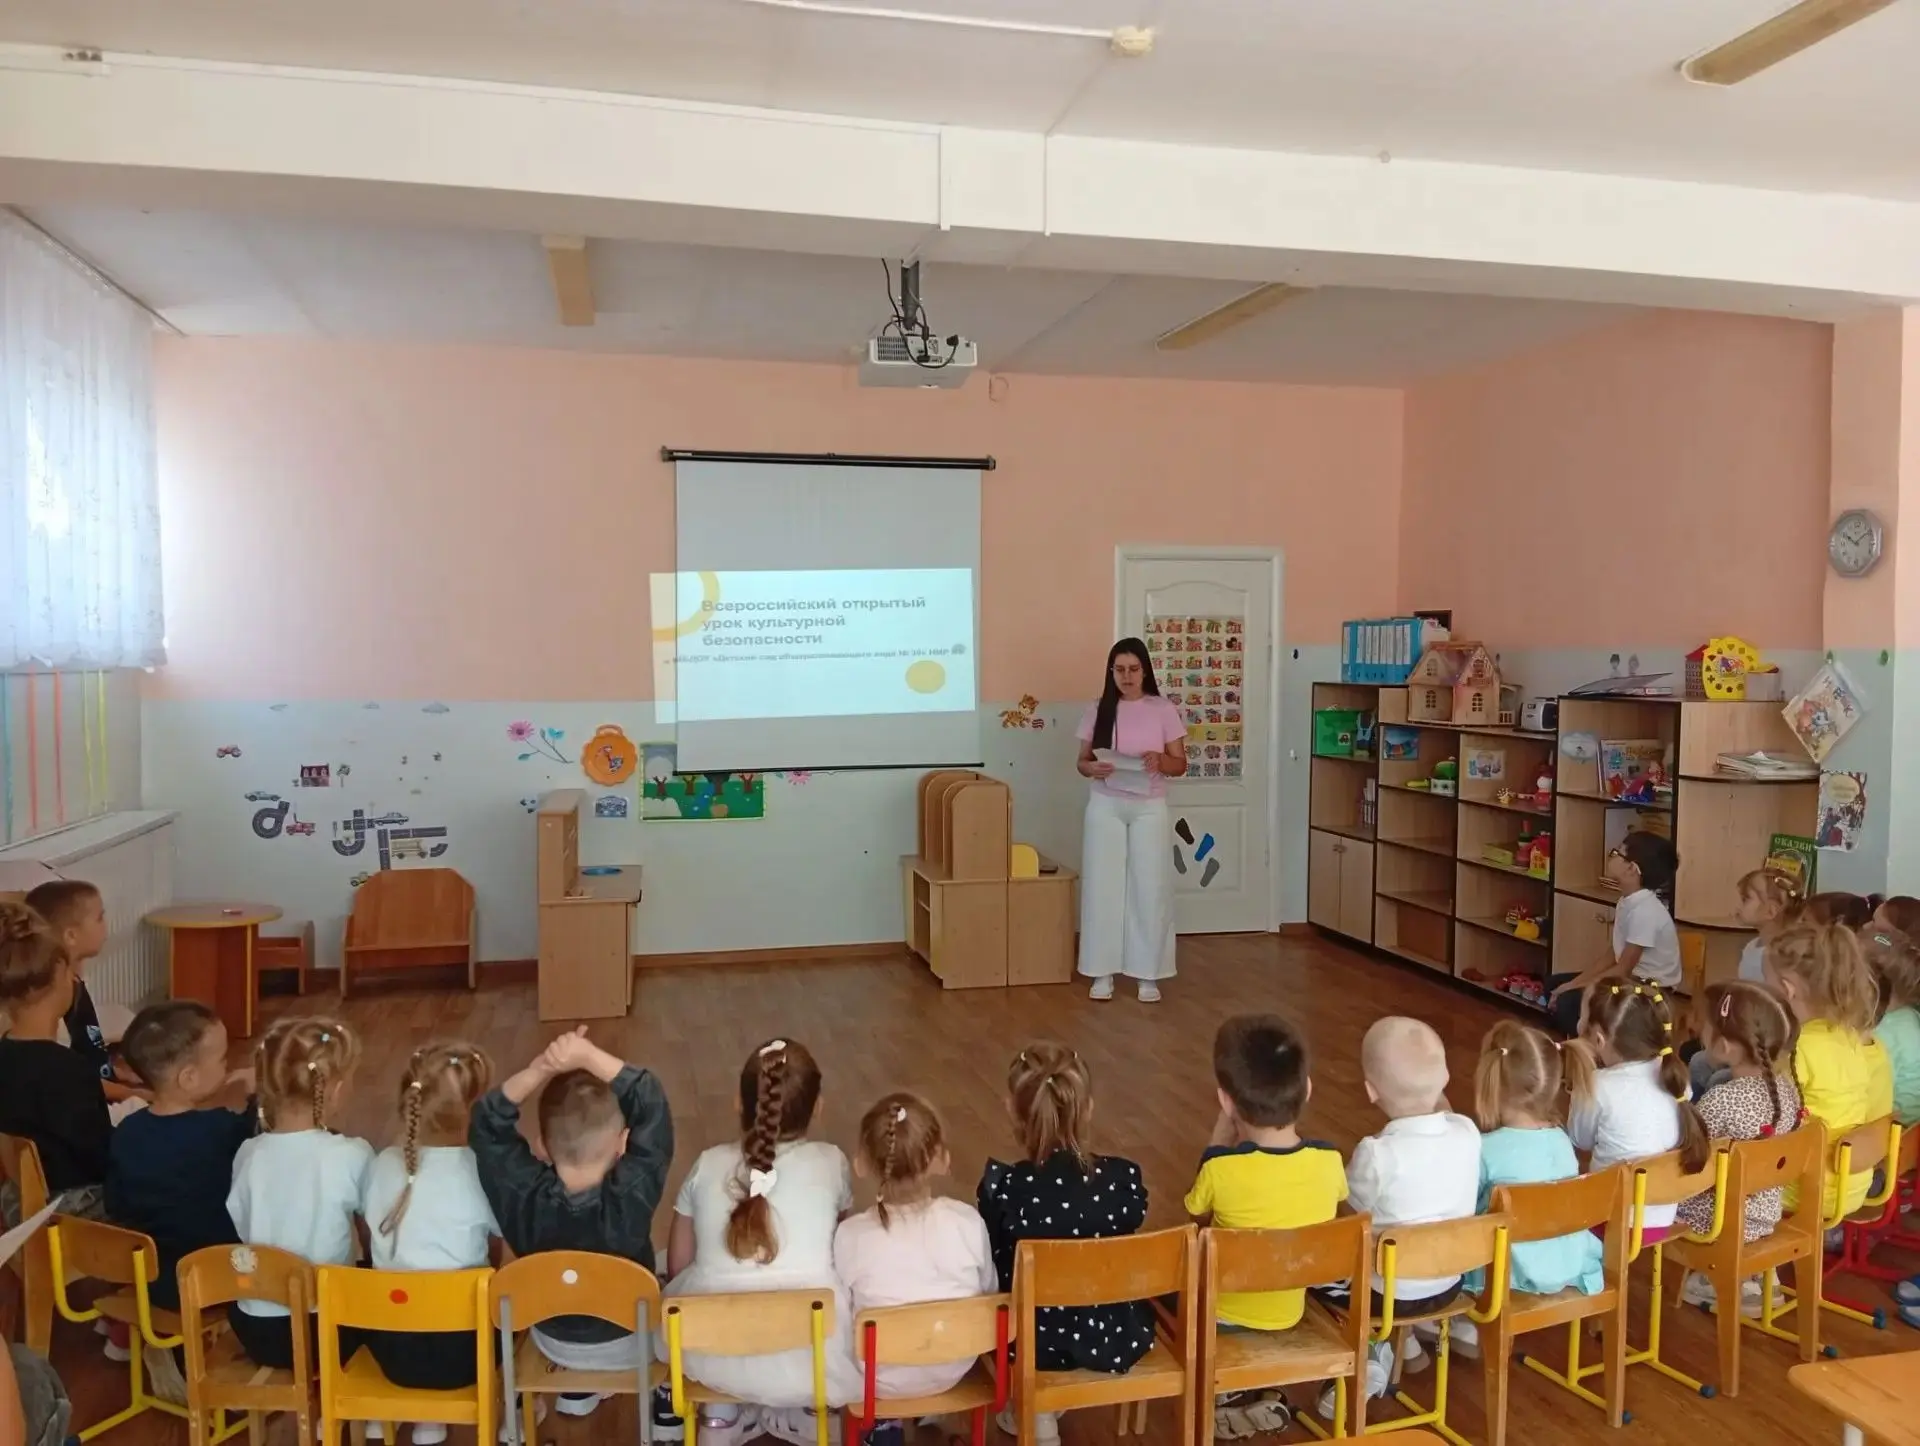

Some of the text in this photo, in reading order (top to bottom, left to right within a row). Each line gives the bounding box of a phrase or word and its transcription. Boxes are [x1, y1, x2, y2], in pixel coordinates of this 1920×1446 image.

[701, 597, 926, 613] Всероссийский открытый
[703, 615, 845, 632] урок культурной
[702, 634, 823, 646] безопасности
